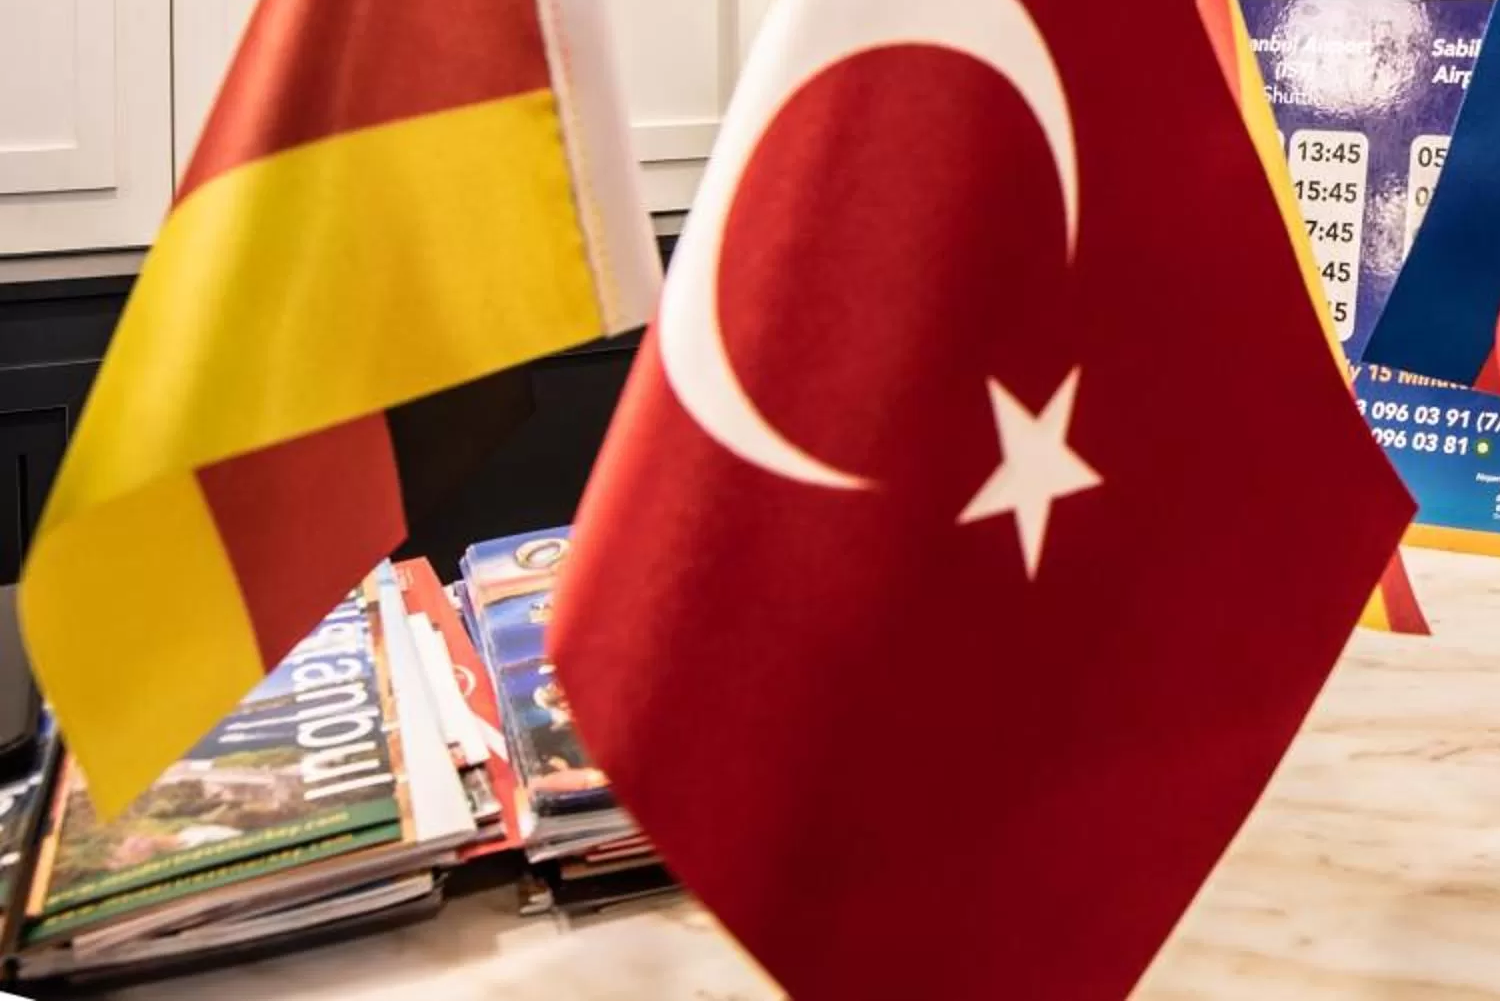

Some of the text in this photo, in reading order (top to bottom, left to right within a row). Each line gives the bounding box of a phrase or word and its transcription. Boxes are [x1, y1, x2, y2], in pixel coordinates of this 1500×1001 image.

[1298, 142, 1361, 163] 13:45
[1294, 181, 1357, 203] 15:45
[1305, 220, 1354, 242] 7:45
[1372, 401, 1409, 422] 096
[1414, 406, 1440, 425] 03
[1446, 409, 1471, 428] 91
[1412, 433, 1439, 452] 03
[1443, 437, 1469, 455] 81
